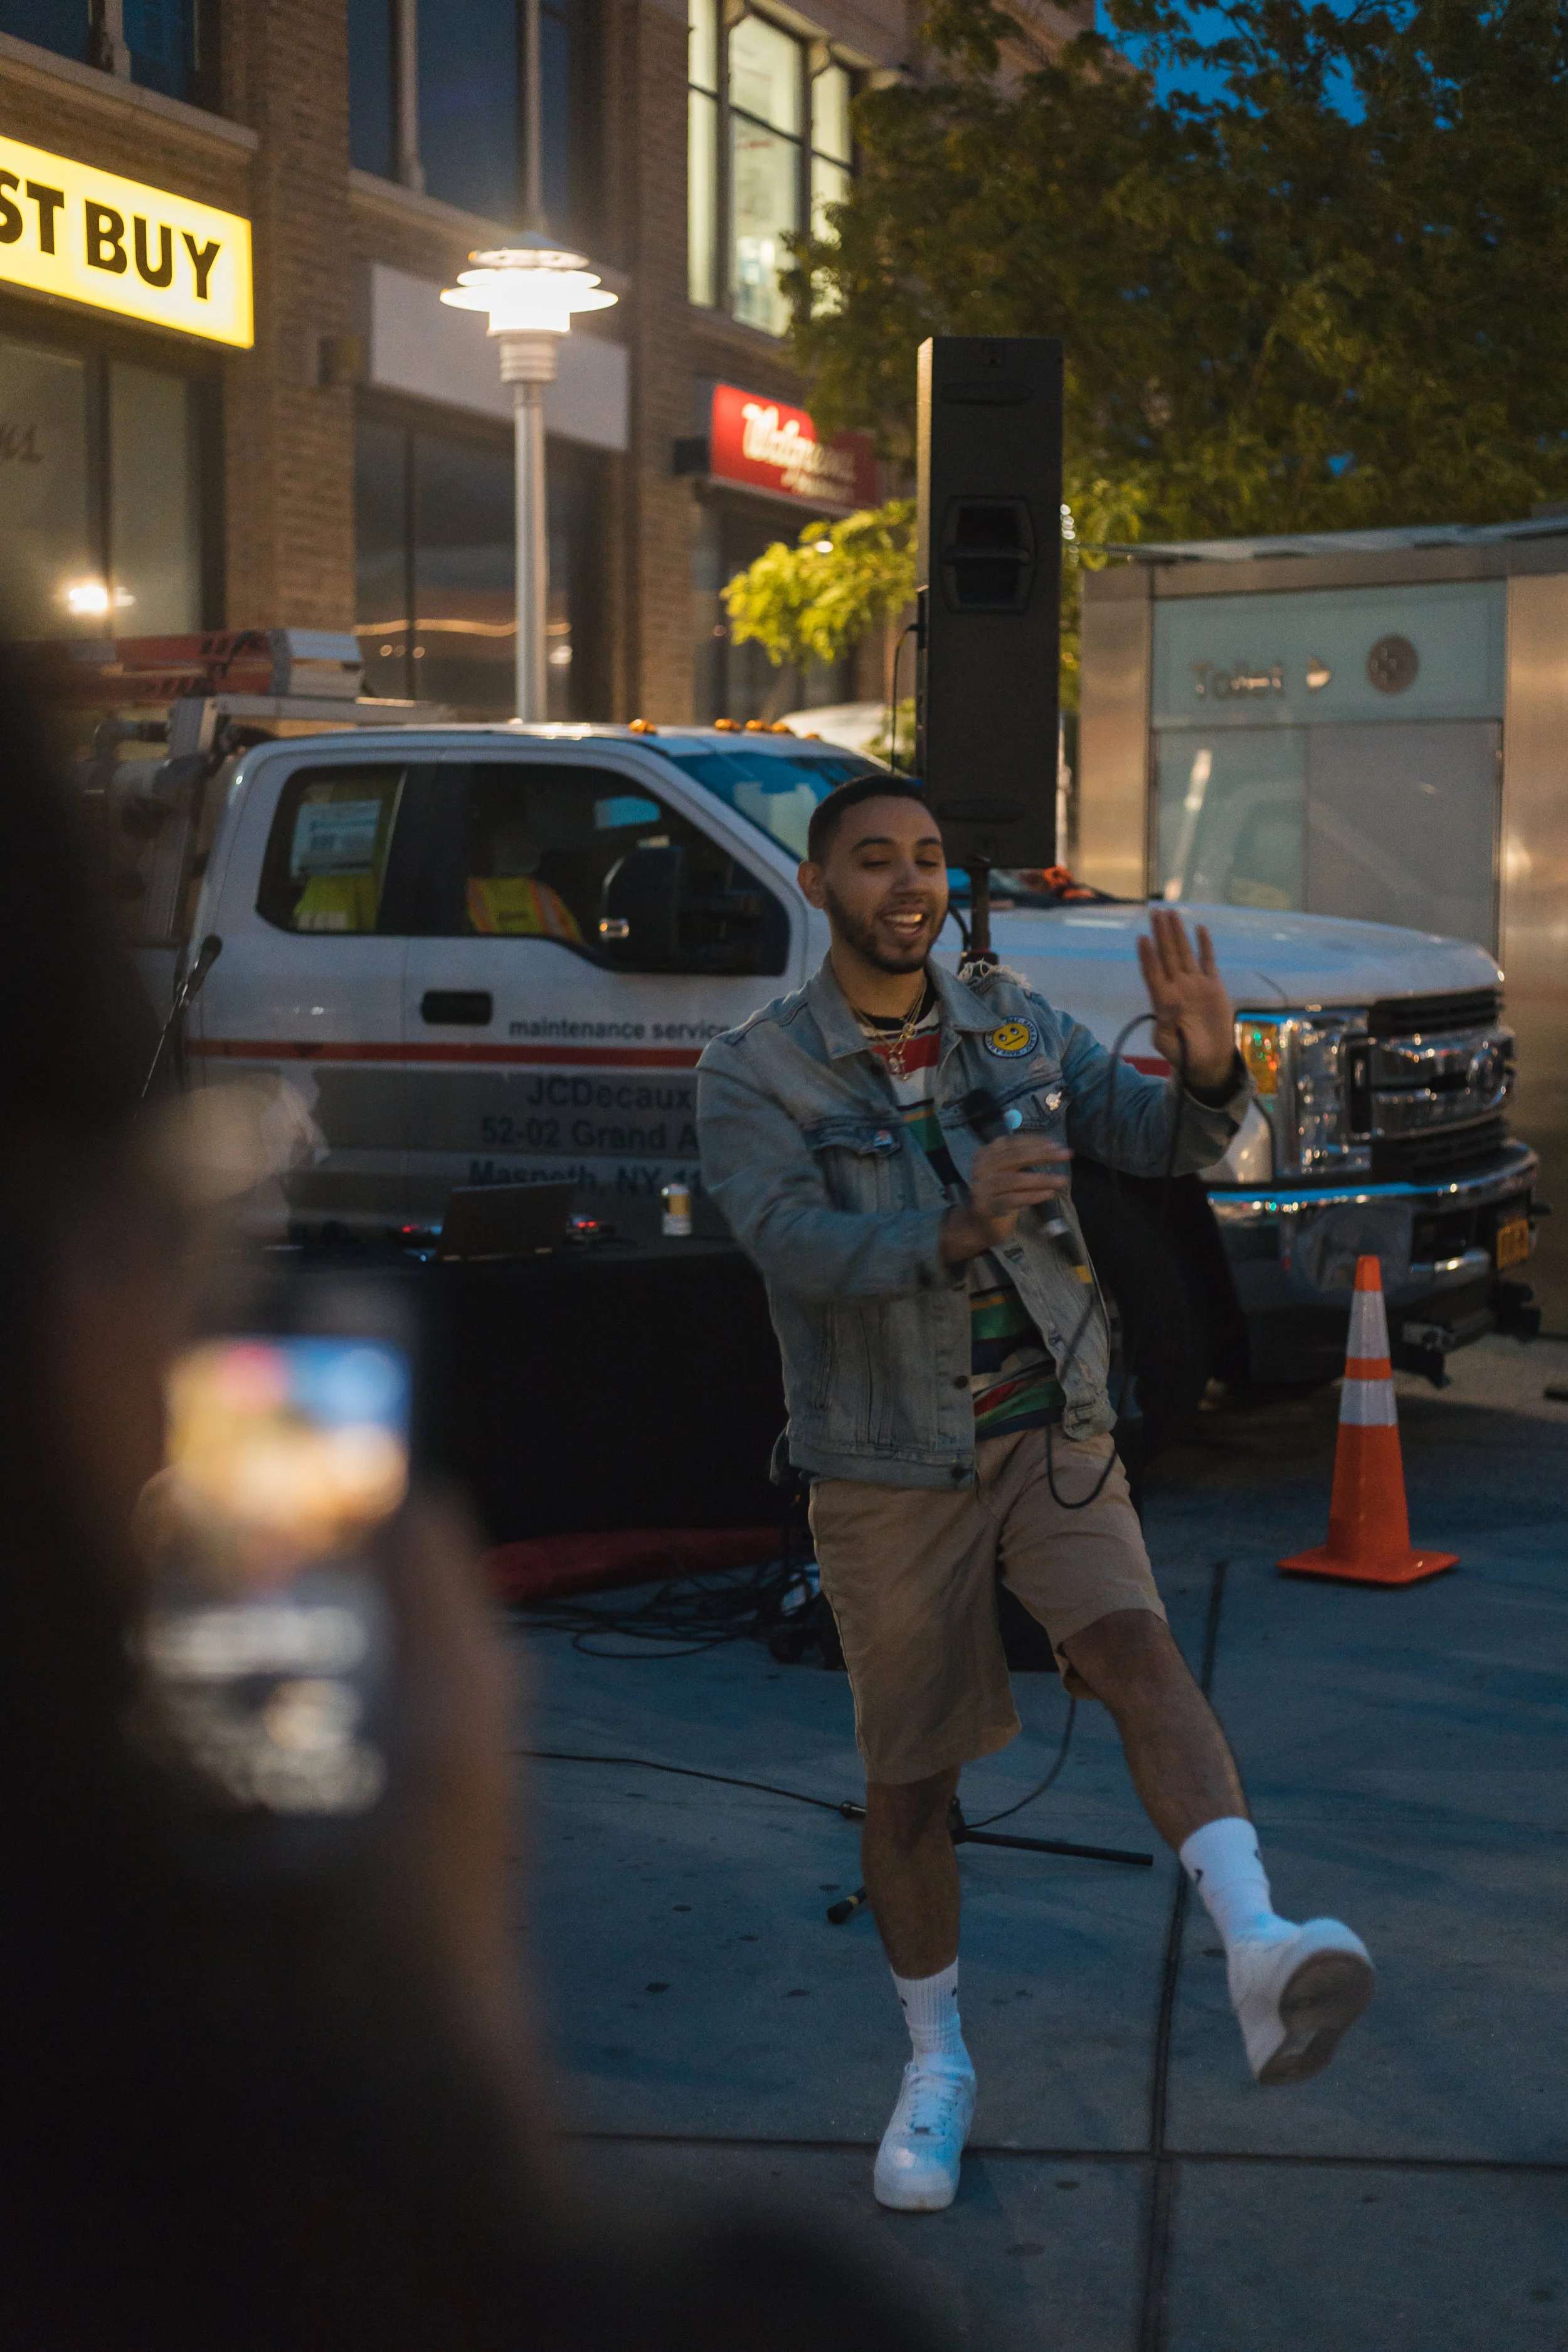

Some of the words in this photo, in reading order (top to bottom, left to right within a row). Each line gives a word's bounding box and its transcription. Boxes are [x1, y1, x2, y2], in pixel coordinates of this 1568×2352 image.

[0, 169, 65, 256] ST
[85, 199, 221, 300] BUY
[509, 1018, 645, 1039] maintenance
[528, 1076, 691, 1110] JCDecaux
[482, 1117, 561, 1148] 52-02
[573, 1120, 668, 1150] Grand
[617, 1165, 662, 1194] NY
